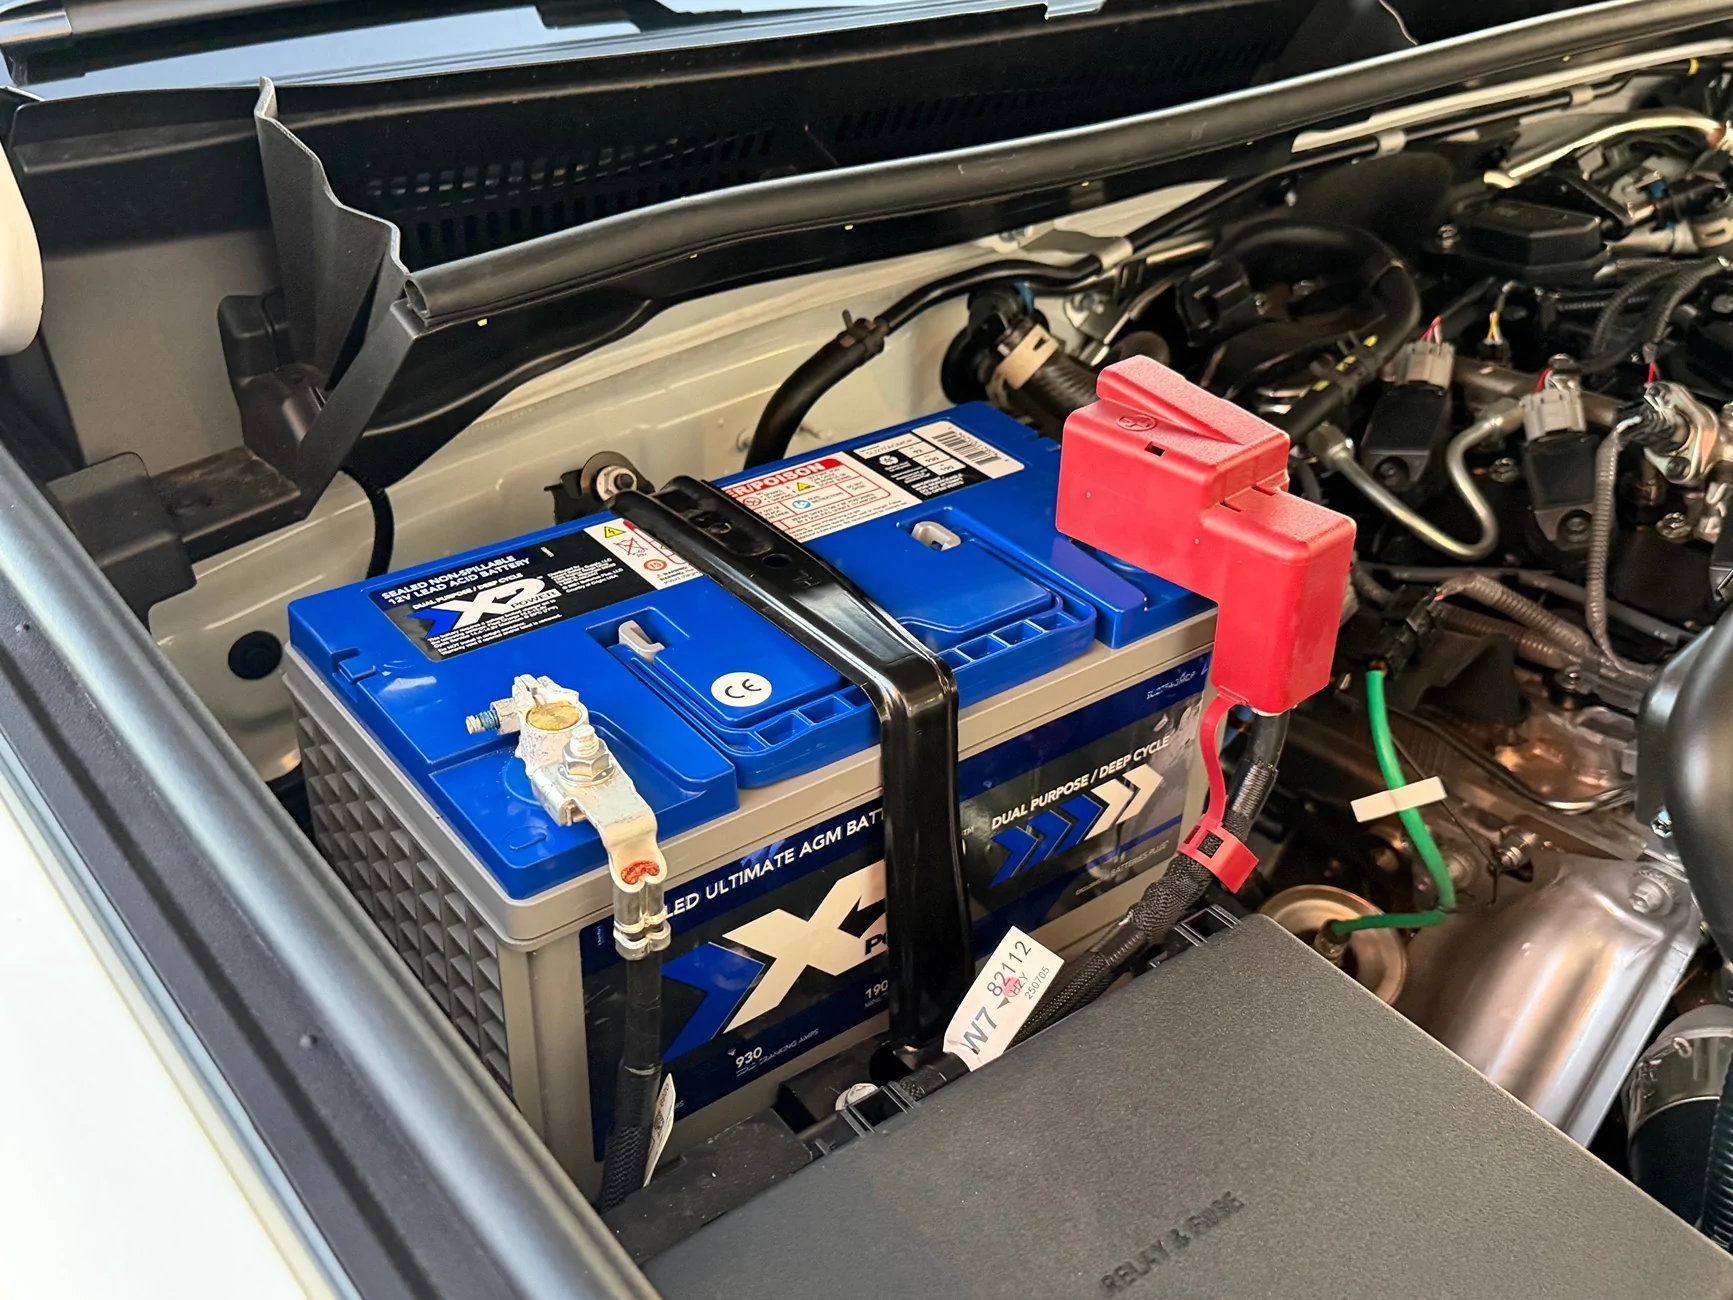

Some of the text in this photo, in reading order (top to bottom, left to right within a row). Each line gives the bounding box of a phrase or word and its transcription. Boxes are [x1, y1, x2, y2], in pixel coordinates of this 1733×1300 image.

[725, 463, 826, 498] ER/POISON
[381, 555, 517, 600] SEALED NON-SPILLABLE
[387, 557, 531, 605] 12V LEAD ACID BATTERY
[412, 599, 439, 610] DUAL
[438, 587, 473, 603] PURPOSE
[477, 580, 499, 590] DEEP
[498, 572, 524, 584] CYCLE
[510, 591, 557, 608] POWER
[991, 735, 1171, 830] DUAL PURPOSE / DEEP CYCLE
[664, 808, 884, 919] LED ULTIMATE AGM BATT
[986, 940, 1032, 997] 82112
[1024, 966, 1050, 1000] 250705
[865, 979, 889, 999] 190
[798, 1028, 819, 1043] AMPS
[735, 1046, 763, 1069] 930
